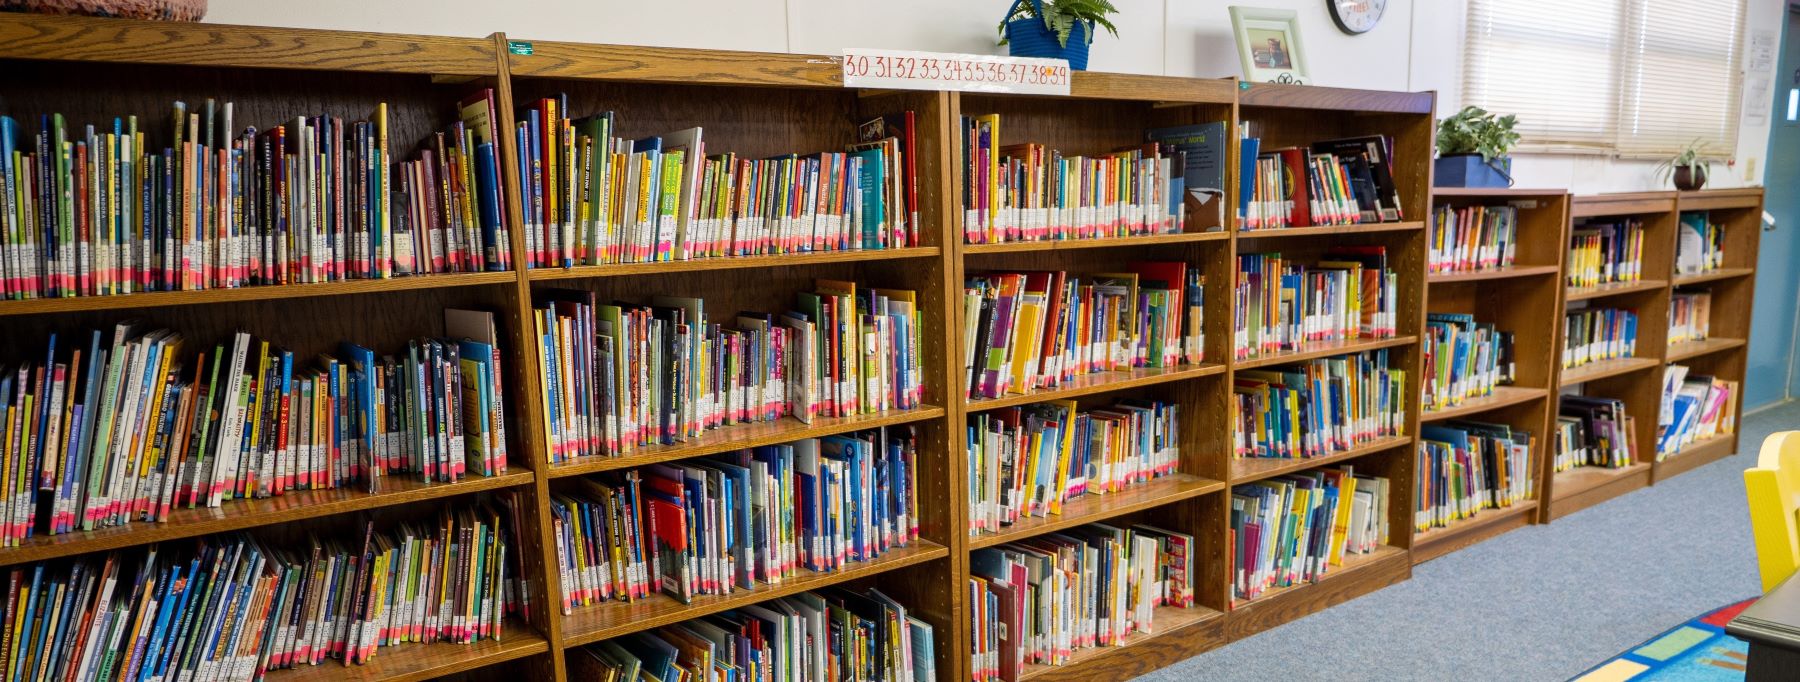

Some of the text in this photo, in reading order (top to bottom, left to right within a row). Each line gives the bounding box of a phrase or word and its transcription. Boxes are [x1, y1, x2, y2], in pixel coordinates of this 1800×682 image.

[846, 55, 1065, 85] 3.0 3.1 3.2 3.3 3.4 3.5 3.6 3.7 3.8 3.9
[158, 384, 172, 432] GERONIMO STILTON
[94, 600, 107, 626] ELIZABITE
[0, 624, 12, 672] BRONZEVILLE
